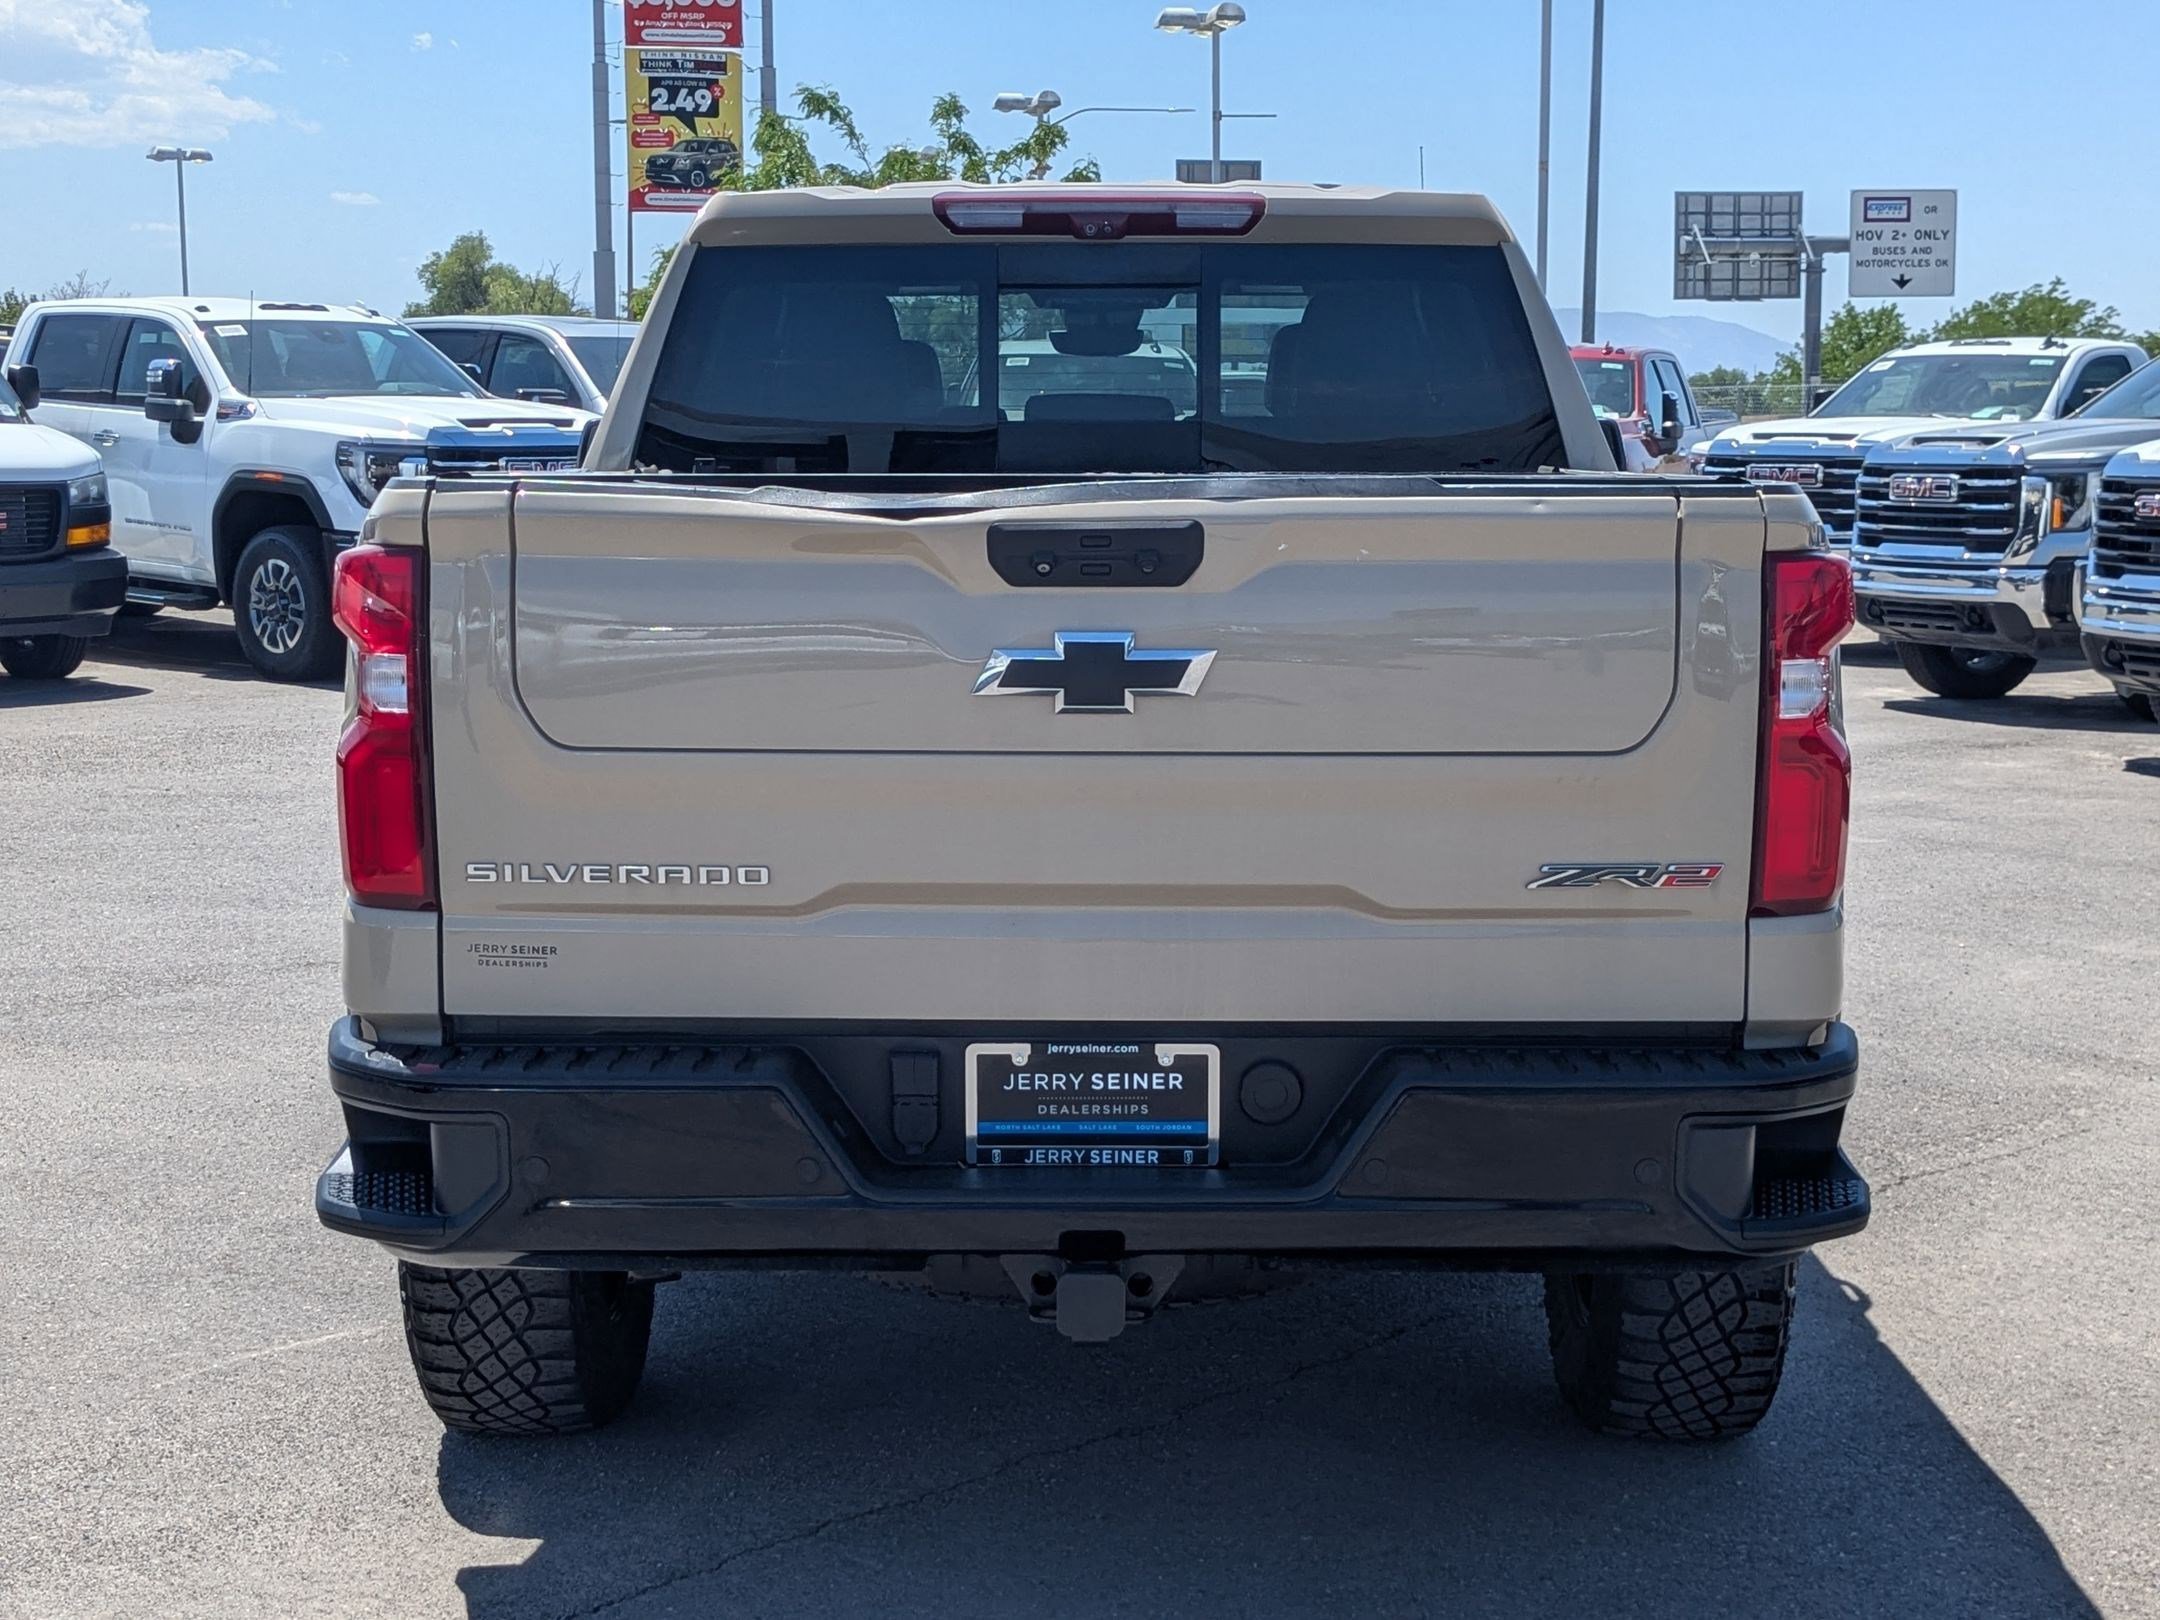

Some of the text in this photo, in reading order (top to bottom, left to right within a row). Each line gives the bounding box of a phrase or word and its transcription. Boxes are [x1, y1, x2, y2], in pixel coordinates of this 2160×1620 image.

[661, 12, 705, 21] OFF MSRP
[681, 52, 723, 60] NISSAN
[642, 60, 673, 68] THINK
[677, 60, 695, 69] TIM
[651, 87, 712, 112] 2.49
[1923, 205, 1938, 214] OR
[1855, 230, 1950, 241] HOV 2+ ONLY
[1872, 246, 1933, 256] BUSES AND
[1856, 259, 1949, 268] MOTORCYCLES OK
[1748, 467, 1816, 483] GMC
[1893, 478, 1951, 497] GMC
[465, 862, 771, 886] SILVERADO
[1525, 863, 1726, 889] ZR2
[467, 943, 558, 956] JERRY SEINER
[477, 958, 549, 969] DEALERSHIPS
[1047, 1043, 1139, 1055] jerryseiner.com
[1003, 1072, 1184, 1091] JERRY SEINER
[1037, 1104, 1150, 1115] DEALERSHIPS
[1024, 1150, 1159, 1164] JERRY SEINER
